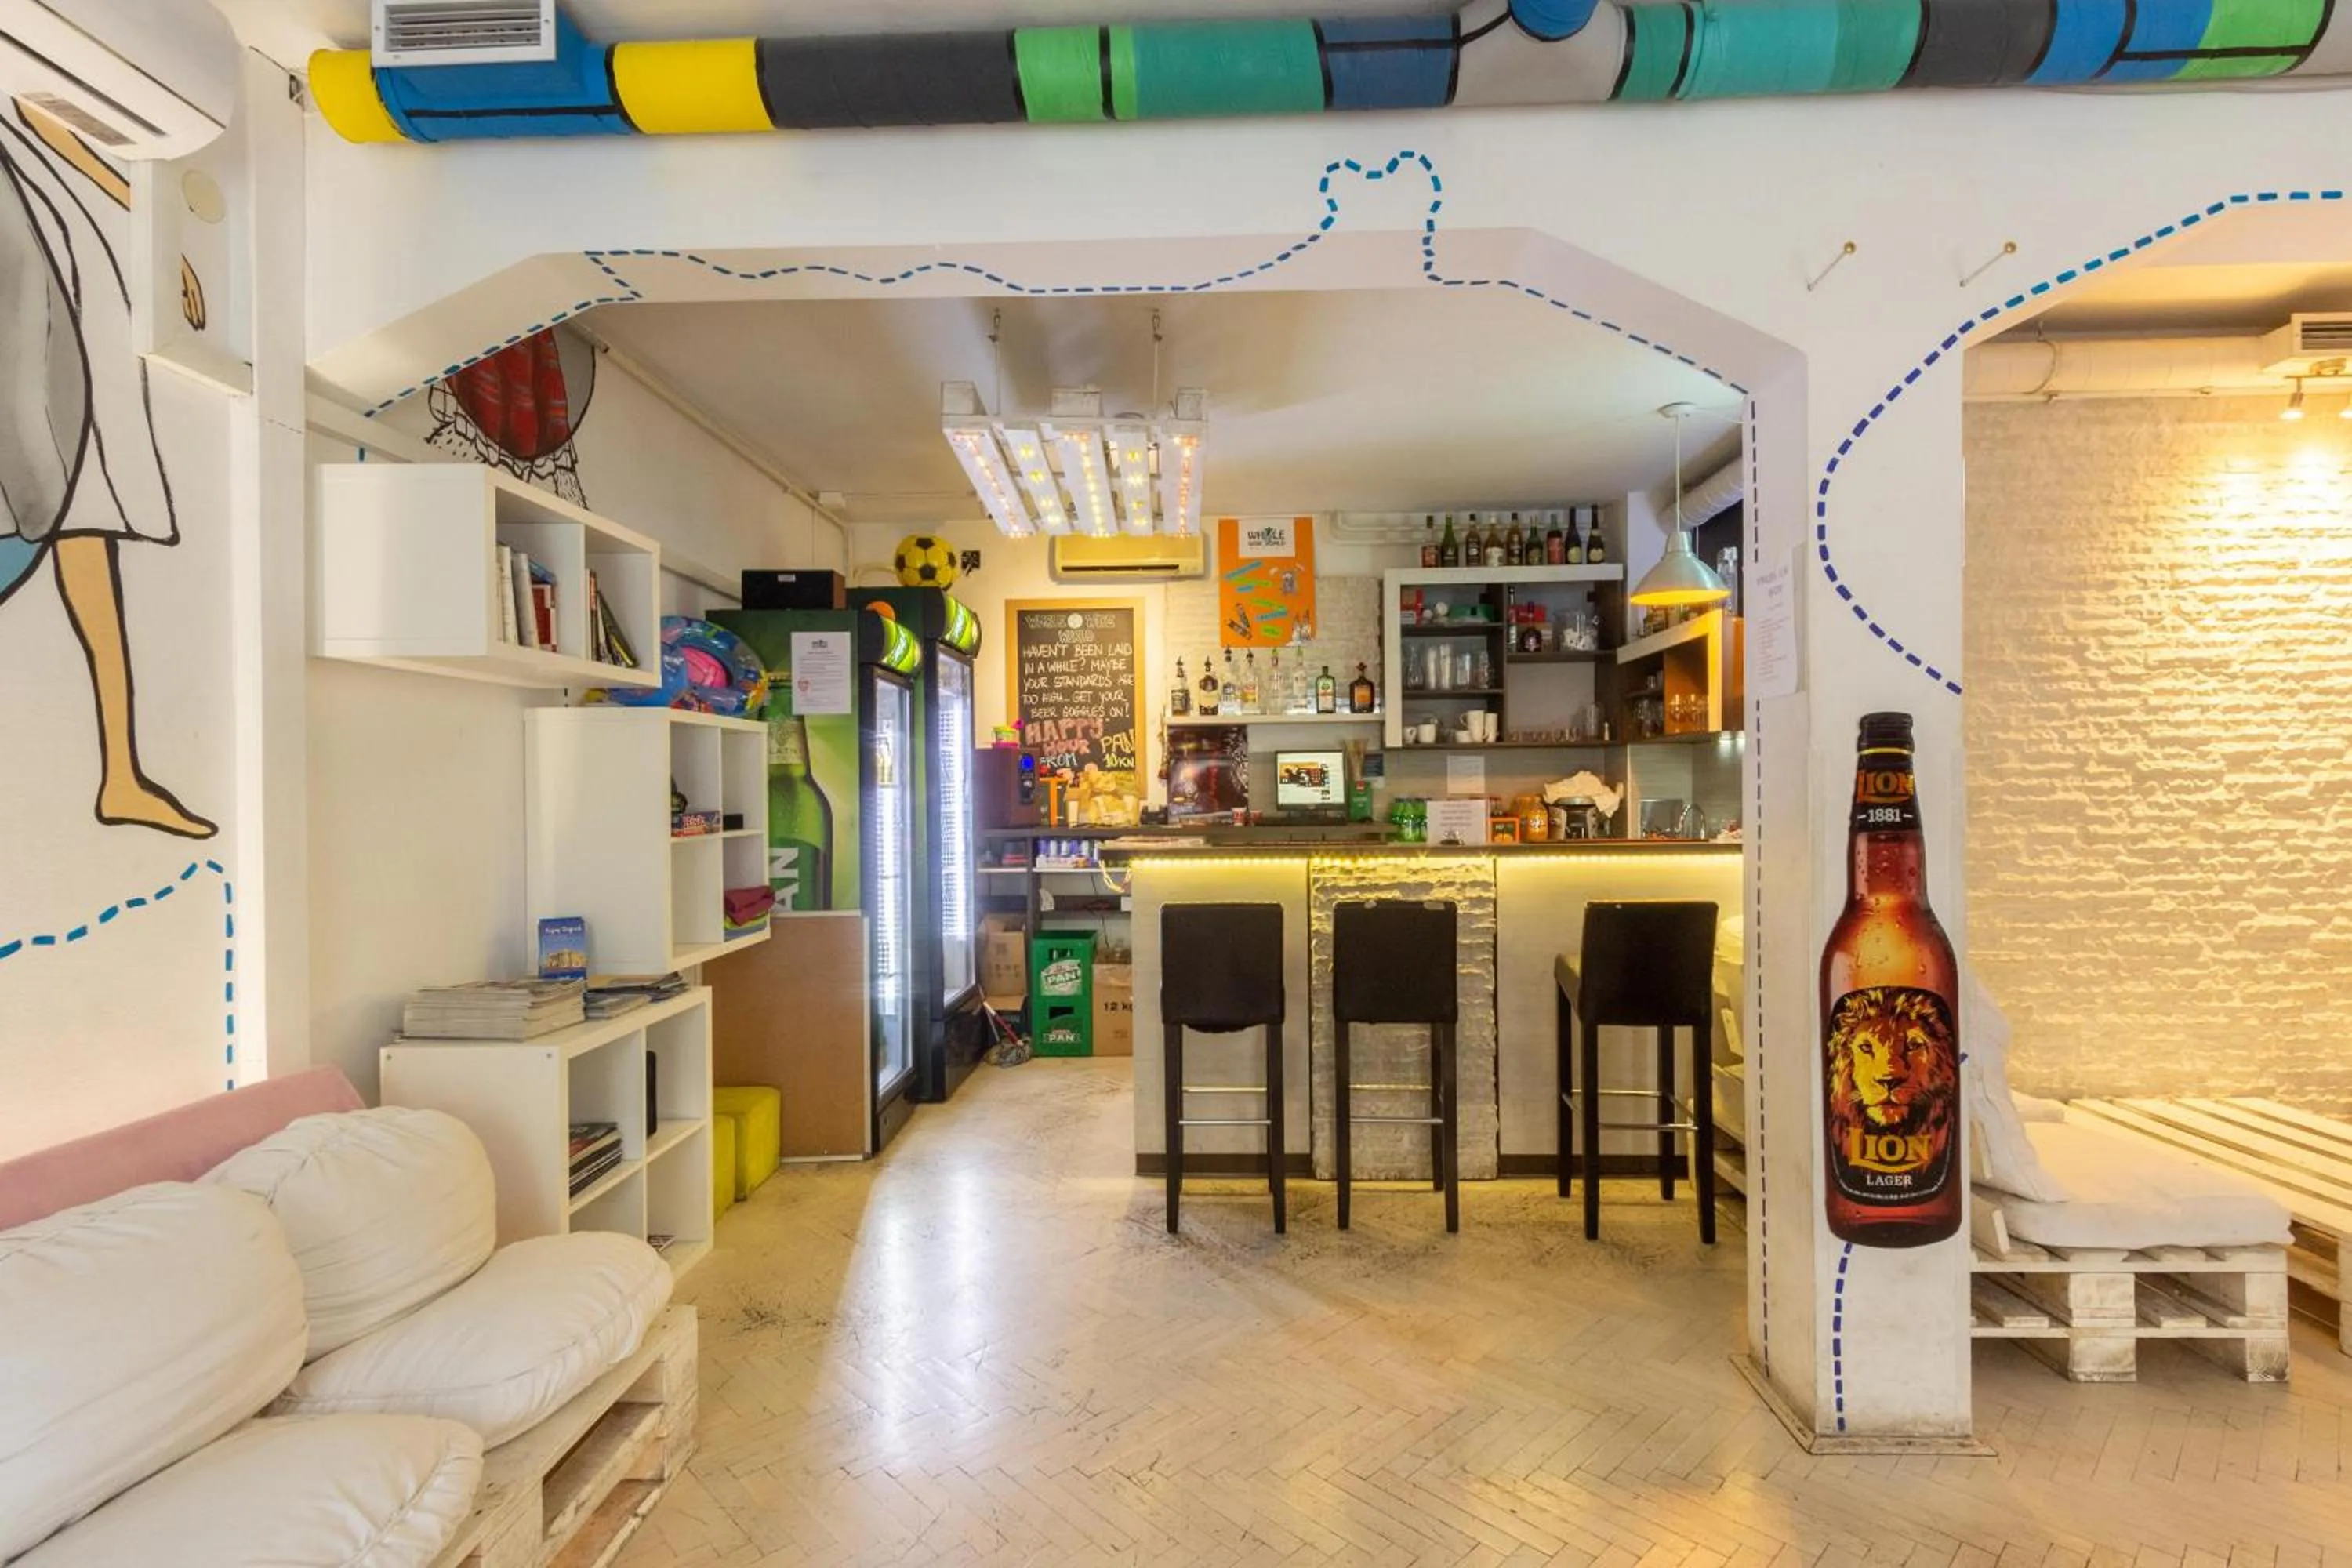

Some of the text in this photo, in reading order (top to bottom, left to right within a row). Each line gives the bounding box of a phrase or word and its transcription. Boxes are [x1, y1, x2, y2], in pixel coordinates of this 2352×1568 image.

[1023, 642, 1133, 658] HAVEN'T BEEN LAID
[1037, 662, 1045, 673] A
[1047, 657, 1086, 673] WHILE?
[1023, 677, 1048, 692] YOUR
[1054, 674, 1112, 688] STANDARDS
[1022, 694, 1039, 706] TOO
[1072, 691, 1093, 703] GET
[1098, 688, 1127, 708] YOUR
[1031, 707, 1058, 719] BEER
[1109, 702, 1130, 717] ON!
[1025, 717, 1104, 746] HAPPY
[1042, 739, 1090, 755] HOUR
[1040, 752, 1078, 768] FROM
[1857, 771, 1915, 804] LION
[769, 847, 799, 910] AN
[1046, 969, 1077, 985] PAN
[1103, 1002, 1118, 1011] 12
[1048, 1033, 1075, 1043] PAN
[1847, 1127, 1932, 1174] LION
[1867, 1174, 1912, 1187] LAGER
